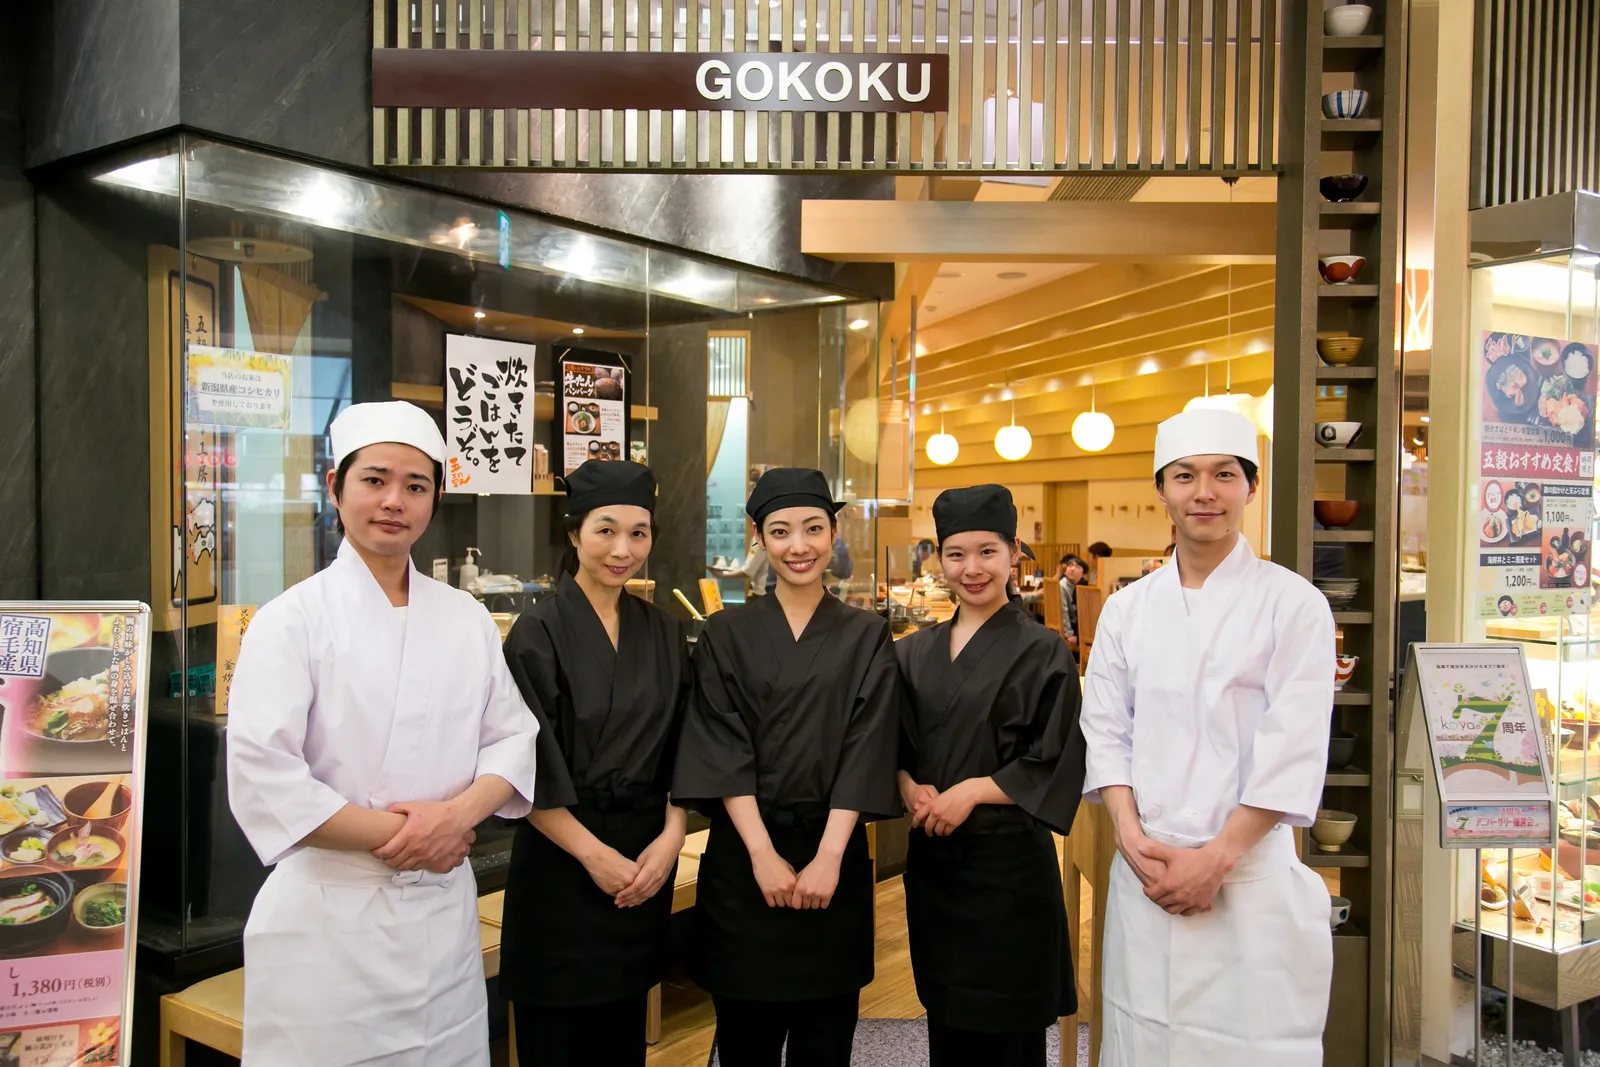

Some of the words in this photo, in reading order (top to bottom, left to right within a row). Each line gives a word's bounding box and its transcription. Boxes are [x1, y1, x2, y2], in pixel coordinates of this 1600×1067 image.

[696, 60, 931, 102] GOKOKU
[201, 381, 280, 398] 新潟県産コシヒカリ
[564, 371, 594, 388] 牛たん
[564, 387, 594, 397] ハンバーグ
[449, 363, 480, 467] どうぞ。
[479, 372, 502, 473] ごはんを
[496, 356, 528, 466] 炊きたて
[0, 617, 24, 672] 宿毛産
[17, 619, 46, 673] 高知県
[1502, 721, 1528, 734] 周年
